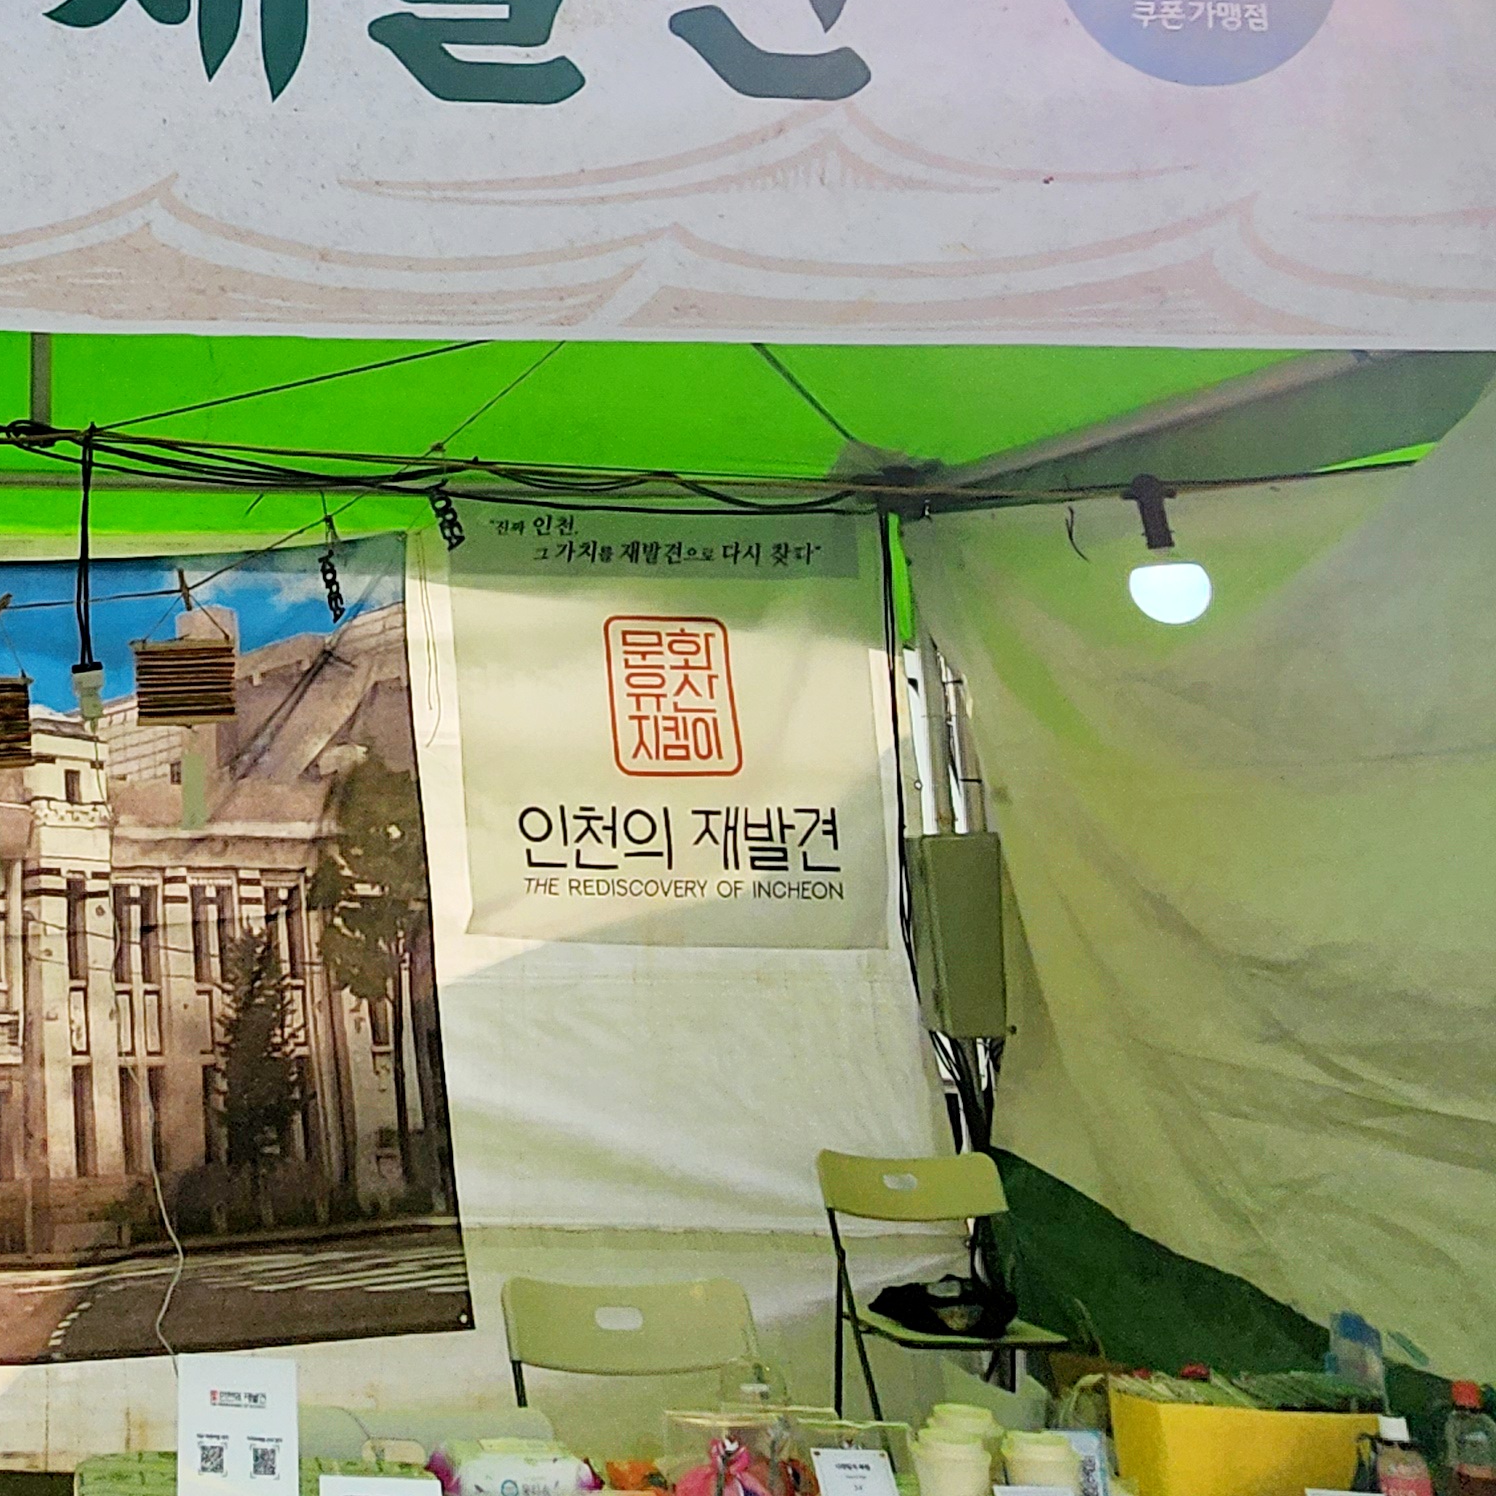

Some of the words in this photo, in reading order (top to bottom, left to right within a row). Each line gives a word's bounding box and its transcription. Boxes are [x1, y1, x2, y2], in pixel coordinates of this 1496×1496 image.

[554, 540, 613, 564] 가치를
[619, 541, 715, 566] 재발견으로
[721, 541, 762, 567] 다시
[621, 628, 716, 671] 문화
[624, 672, 719, 714] 유산
[628, 714, 724, 761] 지킴이
[517, 804, 674, 871] 인천의
[691, 806, 842, 873] 재발견
[524, 878, 560, 896] THE
[569, 879, 709, 898] REDISCOVERY
[716, 881, 745, 899] OF
[753, 882, 844, 900] INCHEON
